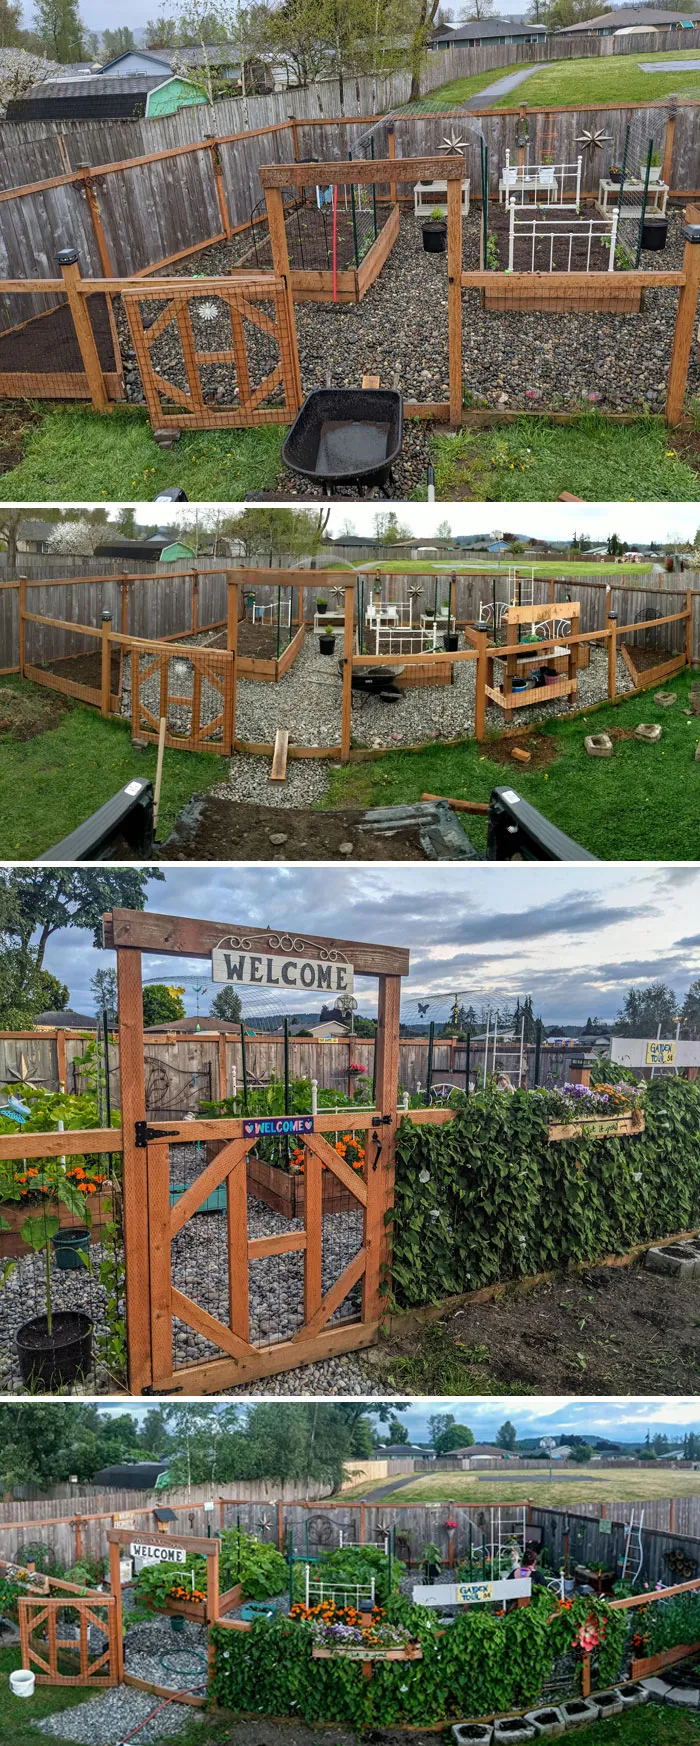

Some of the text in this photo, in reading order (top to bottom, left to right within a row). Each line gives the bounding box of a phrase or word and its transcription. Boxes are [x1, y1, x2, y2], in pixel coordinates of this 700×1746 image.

[223, 953, 348, 991] WELCOME
[650, 1042, 672, 1054] GARDEN
[254, 1119, 305, 1135] WELCOME
[133, 1544, 184, 1562] WELCOME
